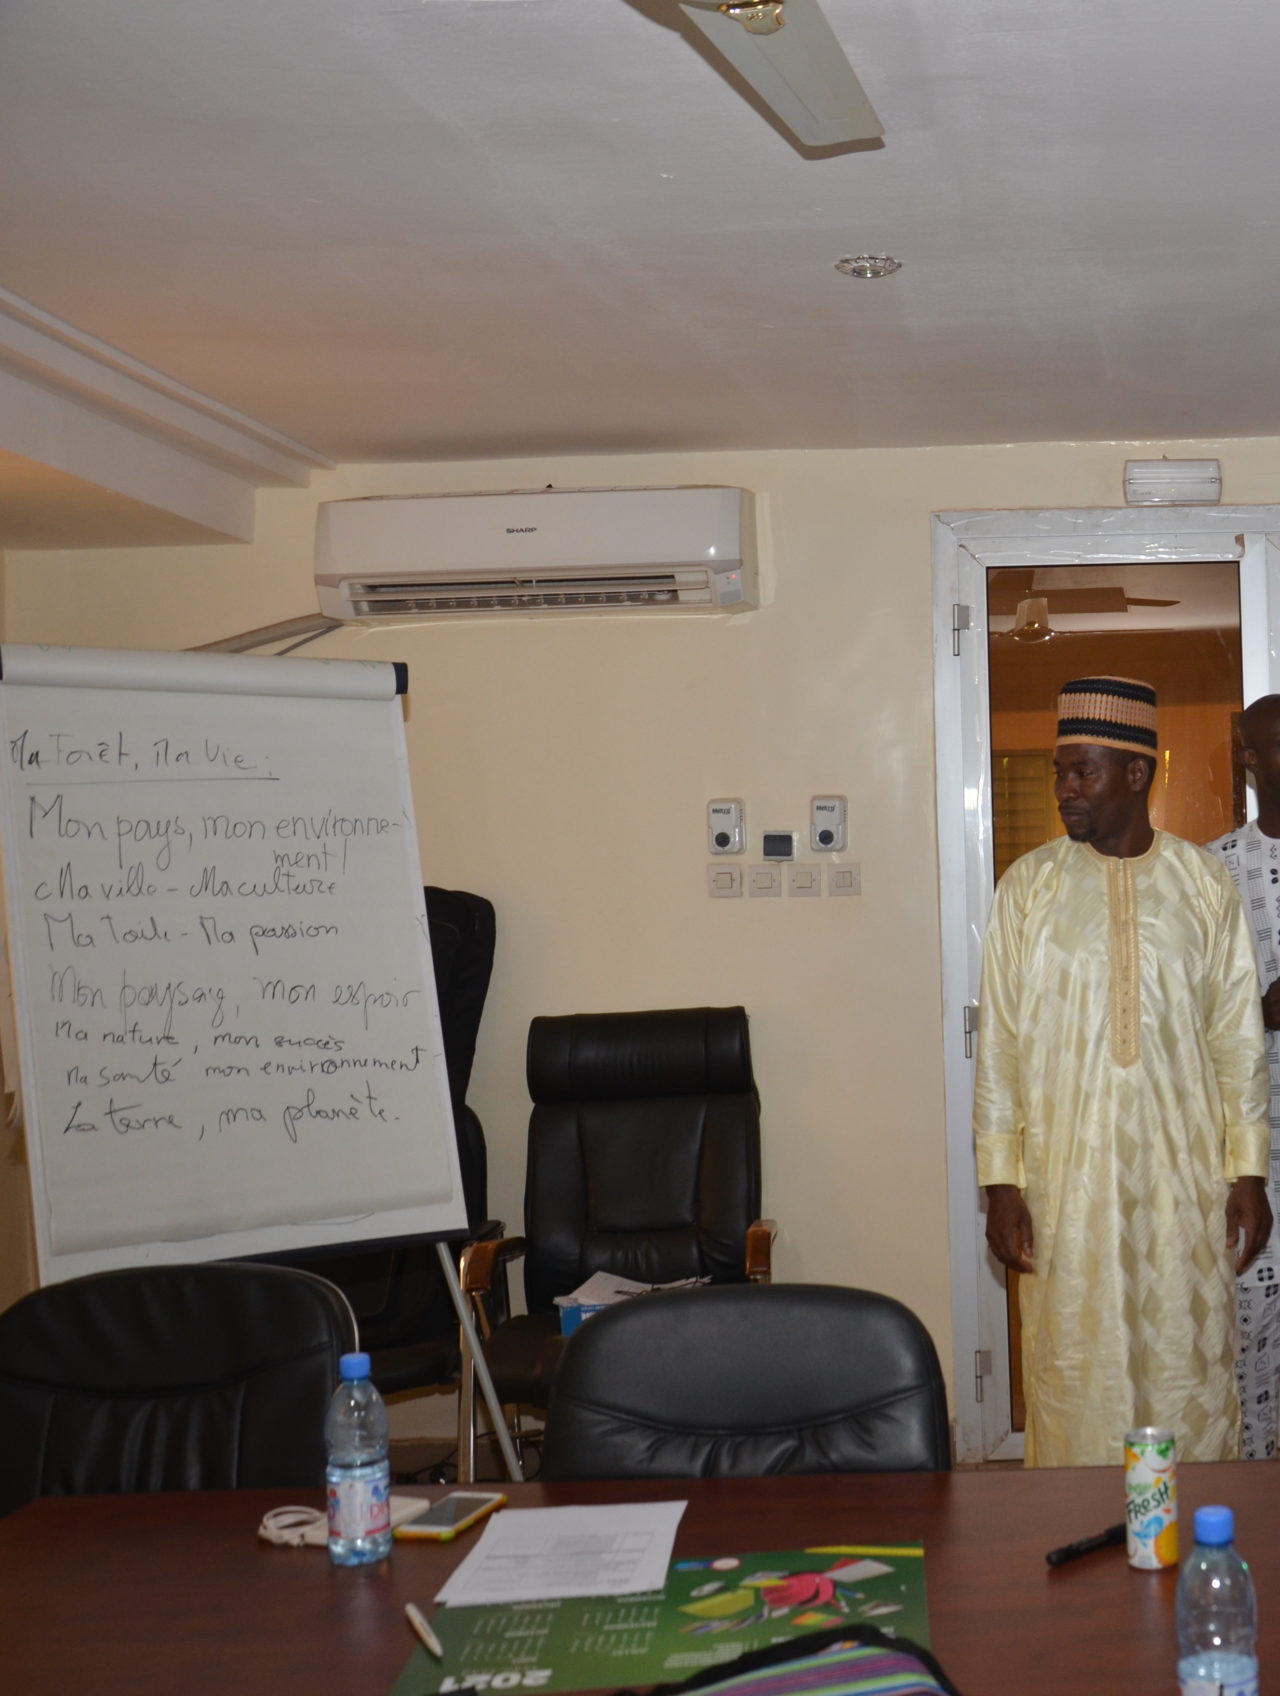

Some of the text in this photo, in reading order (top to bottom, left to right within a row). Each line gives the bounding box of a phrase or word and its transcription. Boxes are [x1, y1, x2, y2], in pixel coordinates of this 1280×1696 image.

[29, 794, 108, 841] Mon
[116, 814, 193, 871] pays,
[202, 814, 267, 841] mon
[100, 861, 158, 900] ville
[237, 865, 337, 896] culture
[43, 912, 96, 951] Ma
[199, 915, 236, 946] Ma
[249, 920, 339, 957] passion
[50, 964, 107, 1009] Mon
[332, 977, 421, 1031] espoir
[213, 1031, 260, 1049] mon
[273, 1034, 346, 1052] succès
[99, 1054, 183, 1088] santé
[204, 1064, 251, 1078] mon
[63, 1100, 99, 1135] La
[218, 1106, 267, 1133] ma
